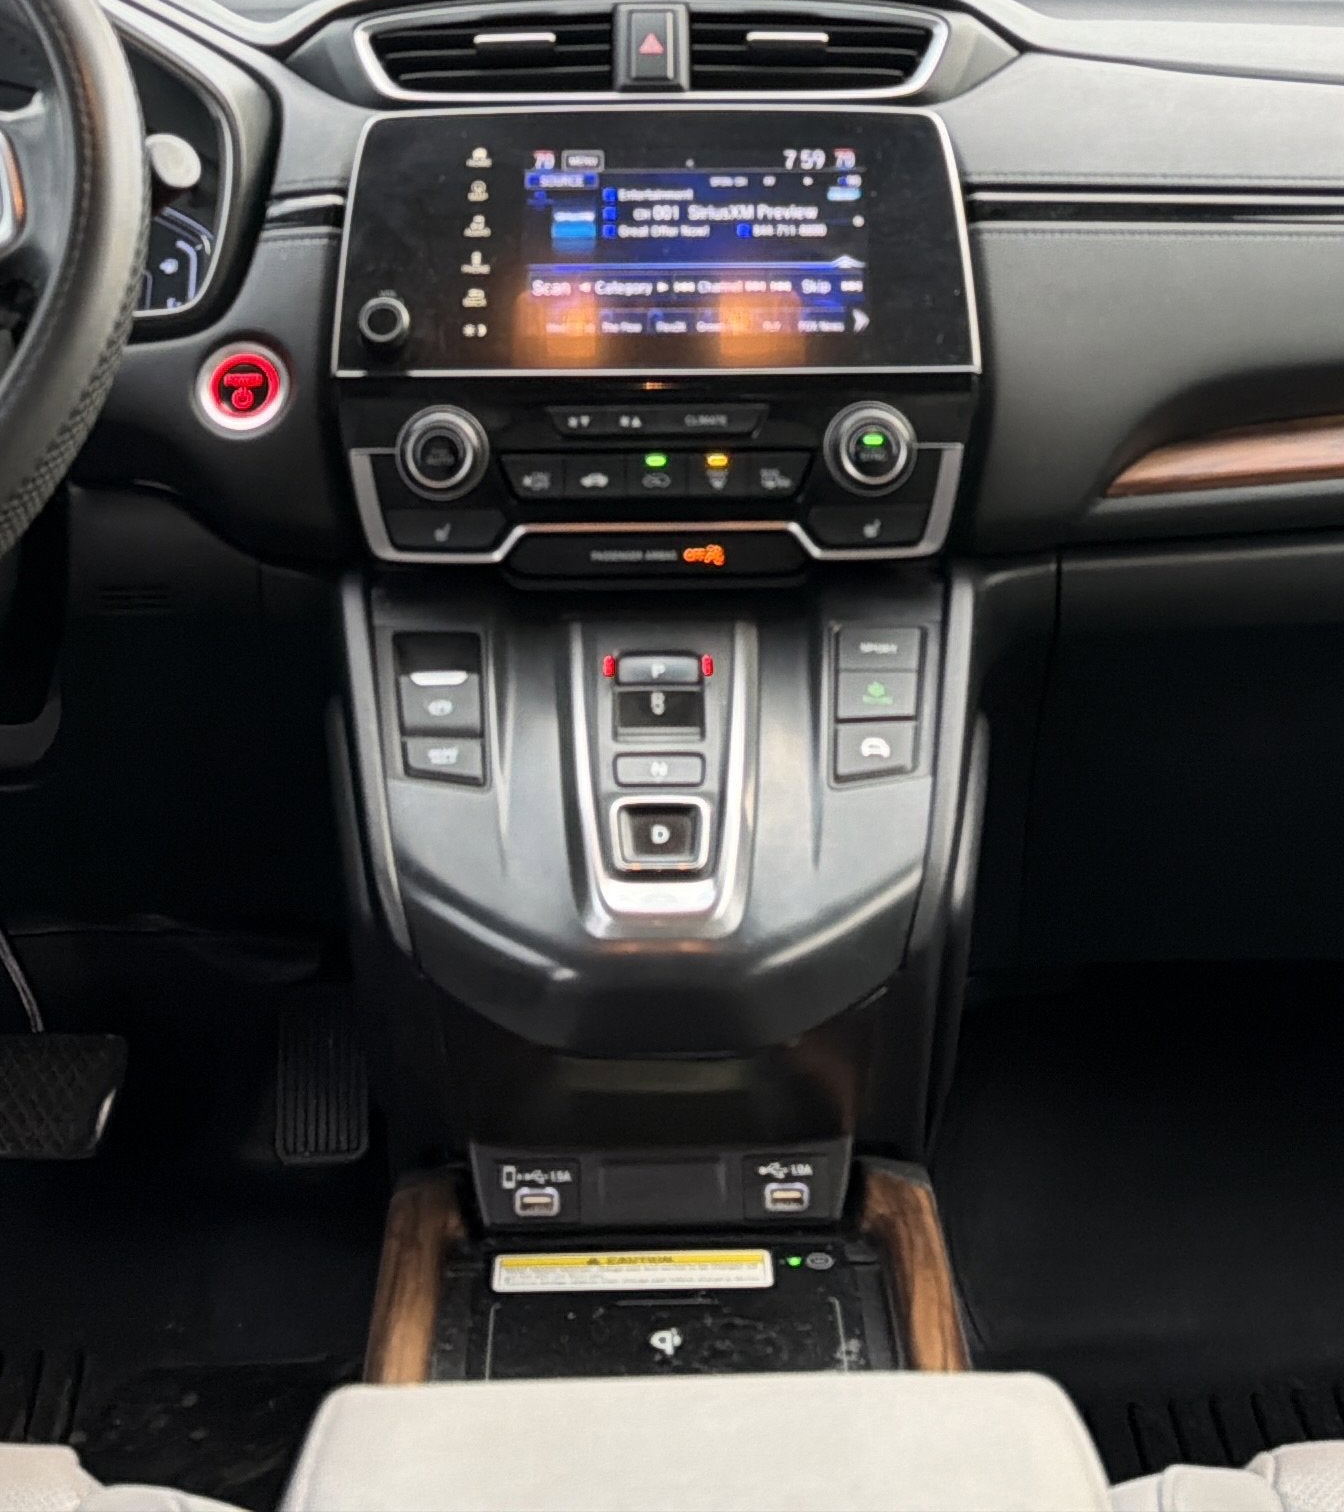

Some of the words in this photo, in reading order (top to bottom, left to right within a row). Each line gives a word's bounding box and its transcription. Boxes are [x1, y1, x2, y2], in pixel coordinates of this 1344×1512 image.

[687, 204, 755, 221] SiriusXM
[756, 204, 819, 221] Preview
[531, 279, 571, 296] Scan
[594, 279, 653, 296] Category
[801, 278, 832, 295] Skip
[651, 824, 670, 844] D
